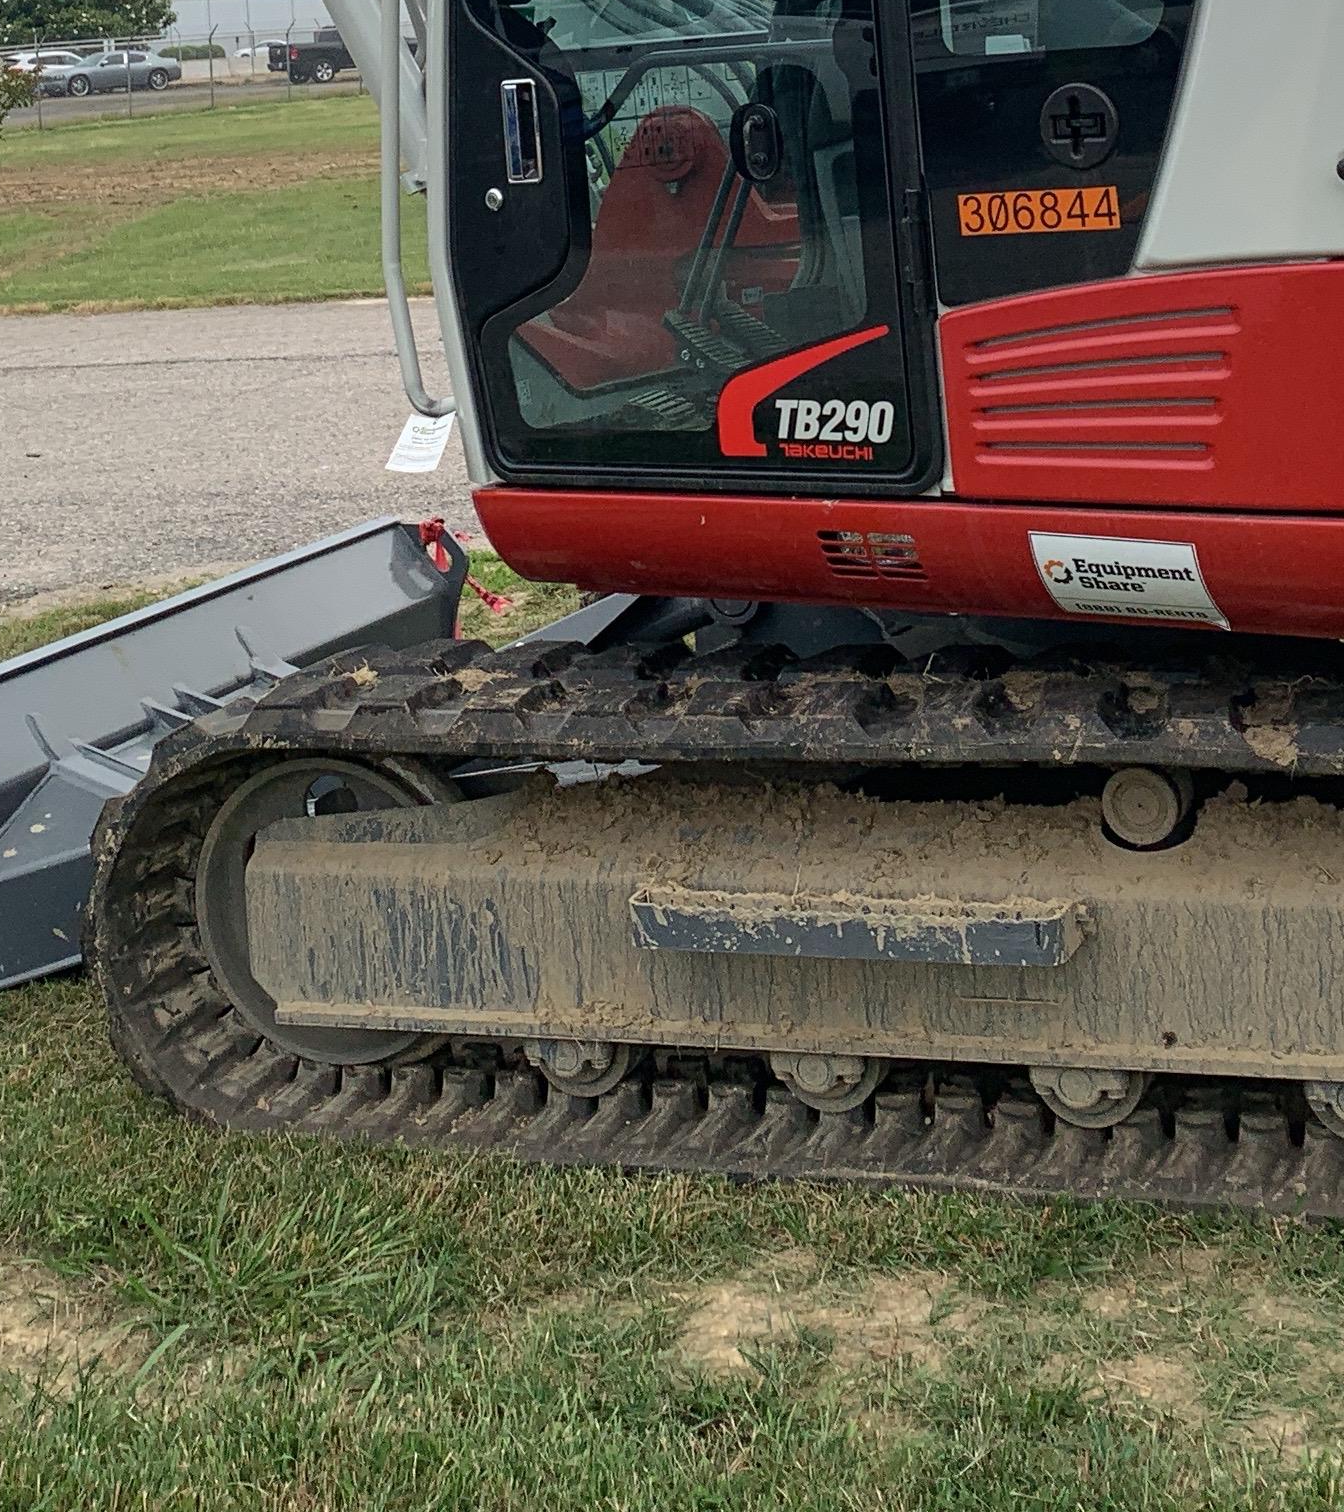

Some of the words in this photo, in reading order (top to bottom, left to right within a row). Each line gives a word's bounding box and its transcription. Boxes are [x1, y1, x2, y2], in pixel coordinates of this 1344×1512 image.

[962, 187, 1117, 234] 306844
[774, 398, 895, 444] TB290
[1071, 557, 1196, 582] Equipment
[1078, 575, 1146, 594] Share
